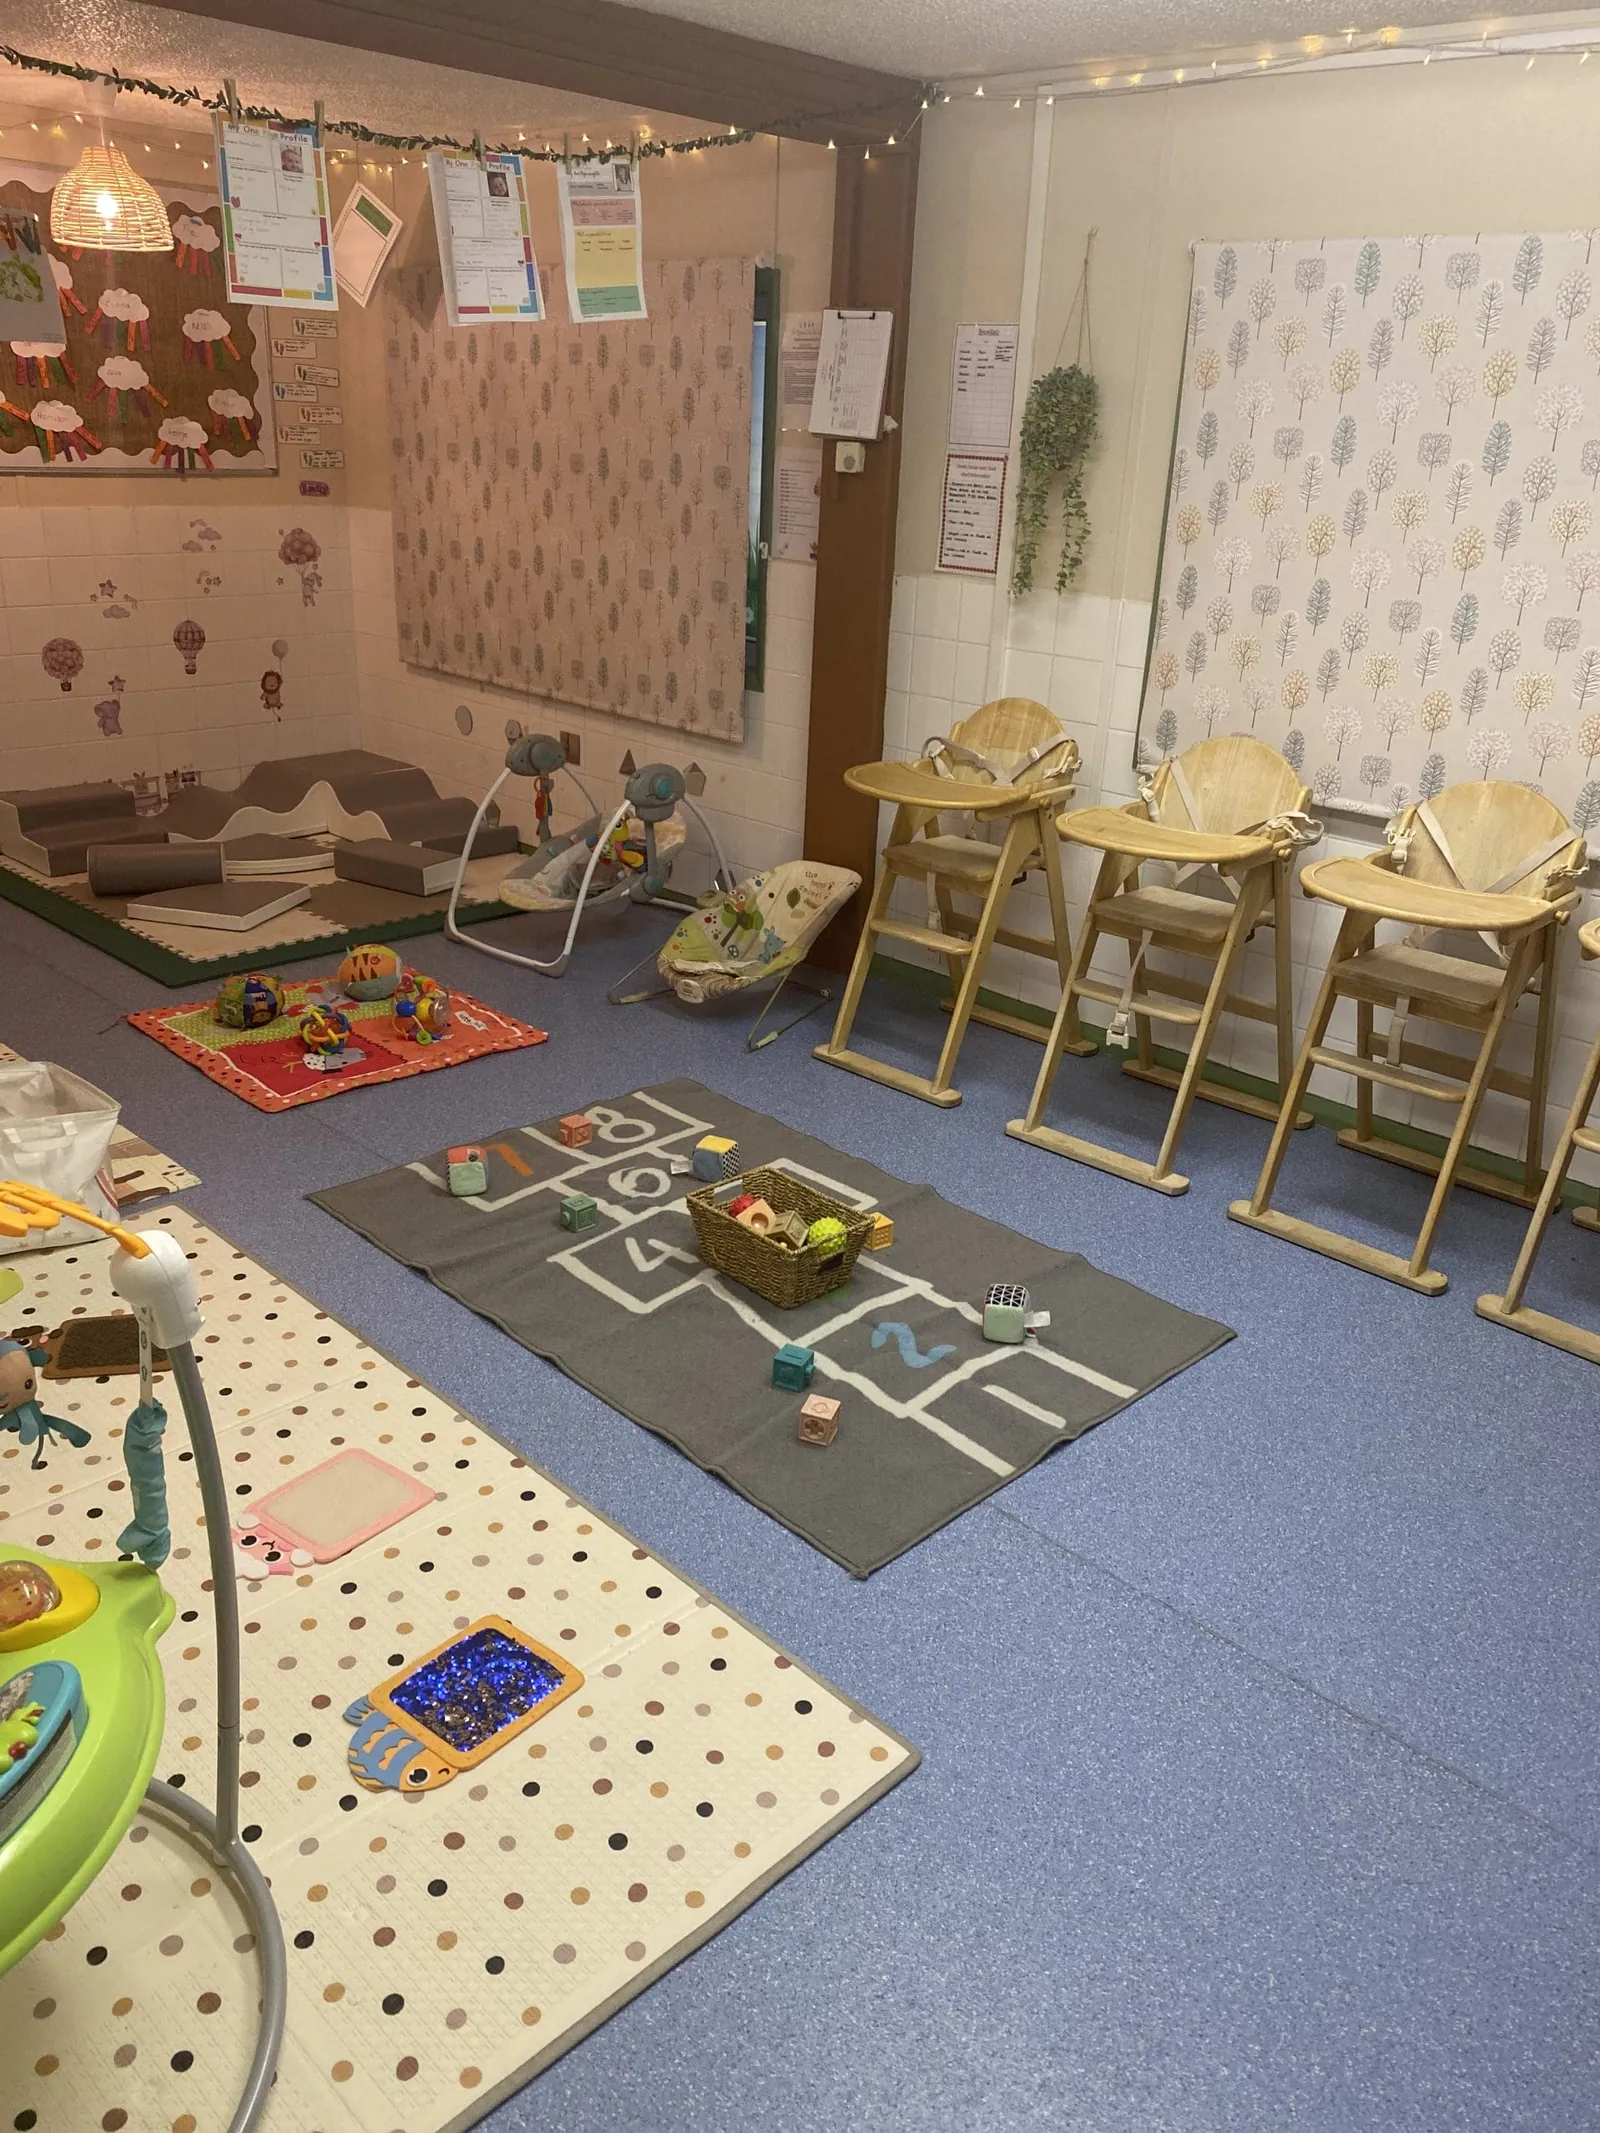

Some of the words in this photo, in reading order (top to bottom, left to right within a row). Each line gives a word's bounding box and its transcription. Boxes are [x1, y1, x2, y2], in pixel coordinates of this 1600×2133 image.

[228, 123, 239, 133] My
[243, 126, 260, 134] One
[280, 133, 308, 143] Profile
[455, 159, 469, 168] One
[488, 162, 511, 171] Profile
[805, 870, 818, 878] the
[583, 1105, 657, 1144] 8
[607, 1165, 672, 1198] 6
[624, 1236, 700, 1273] 4
[871, 1321, 958, 1369] 2
